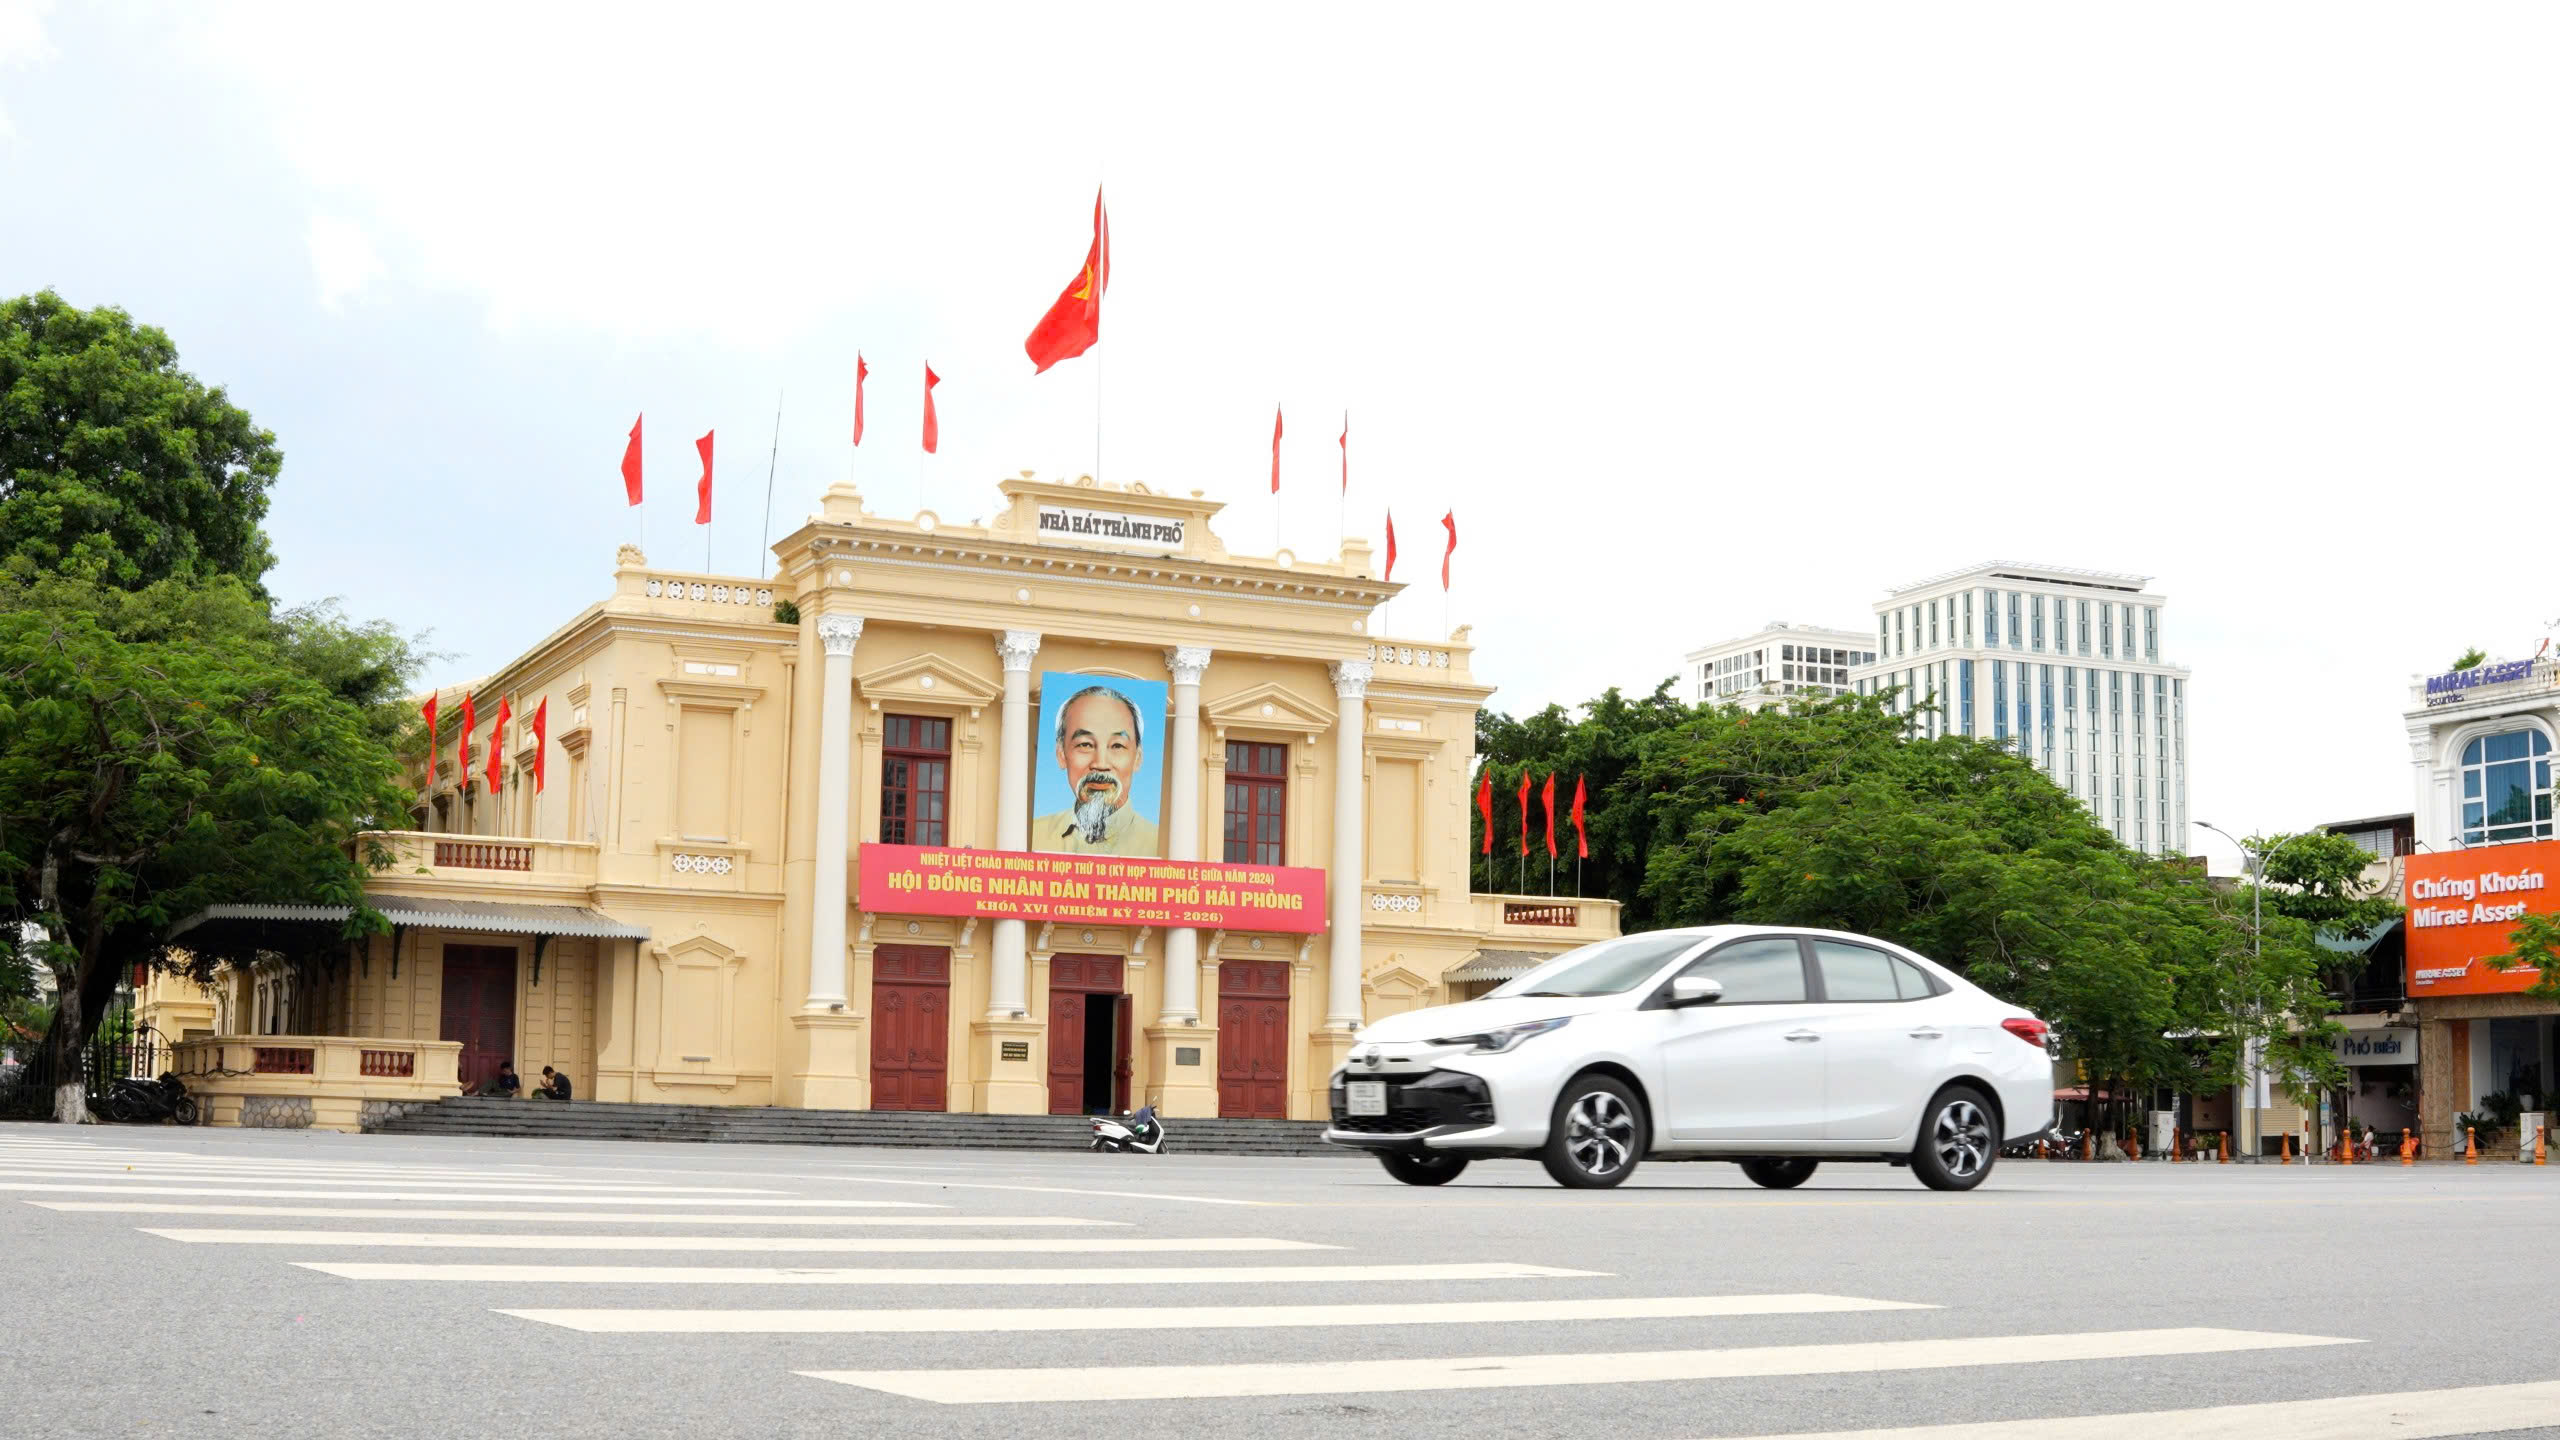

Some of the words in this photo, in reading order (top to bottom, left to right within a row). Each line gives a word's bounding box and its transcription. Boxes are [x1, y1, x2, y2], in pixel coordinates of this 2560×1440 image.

[1039, 510, 1070, 532] NHÀ
[1072, 512, 1101, 535] HÁT
[1102, 516, 1152, 540] THÀNH
[1153, 521, 1184, 543] PHỐ
[2427, 669, 2481, 694] MIRAE
[2482, 660, 2534, 686] ASSET
[920, 851, 949, 868] NHIỆT
[952, 853, 973, 870] LIỆT
[975, 854, 1001, 870] CHÀO
[1004, 856, 1034, 872] MỪNG
[1036, 857, 1049, 873] KỲ
[1052, 859, 1072, 876] HỌP
[1074, 860, 1095, 876] THỨ
[1096, 864, 1106, 876] 18
[1108, 861, 1124, 878] (KỲ
[1127, 865, 1146, 881] HỌP
[1149, 865, 1186, 881] THƯỜNG
[1187, 866, 1199, 884] LỆ
[1201, 868, 1223, 882] GIỮA
[1225, 869, 1247, 883] NĂM
[1249, 872, 1275, 885] 2024)
[2412, 876, 2475, 901] Chứng
[2479, 868, 2544, 894] Khoán
[888, 869, 922, 893] HỘI
[927, 869, 982, 893] ĐỒNG
[988, 876, 1044, 897] NHÂN
[1050, 879, 1090, 899] DÂN
[1095, 882, 1157, 903] THÀNH
[1162, 883, 1200, 905] PHỐ
[1205, 885, 1236, 907] HẢI
[1241, 889, 1303, 910] PHÒNG
[976, 900, 1018, 912] KHÓA
[1022, 903, 1048, 914] XVI
[1053, 904, 1108, 918] (NHIỆM
[1112, 905, 1133, 918] KỲ
[1137, 908, 1171, 920] 2021
[1183, 911, 1224, 923] 2026)
[2413, 906, 2468, 928] Mirae
[2471, 901, 2527, 924] Asset
